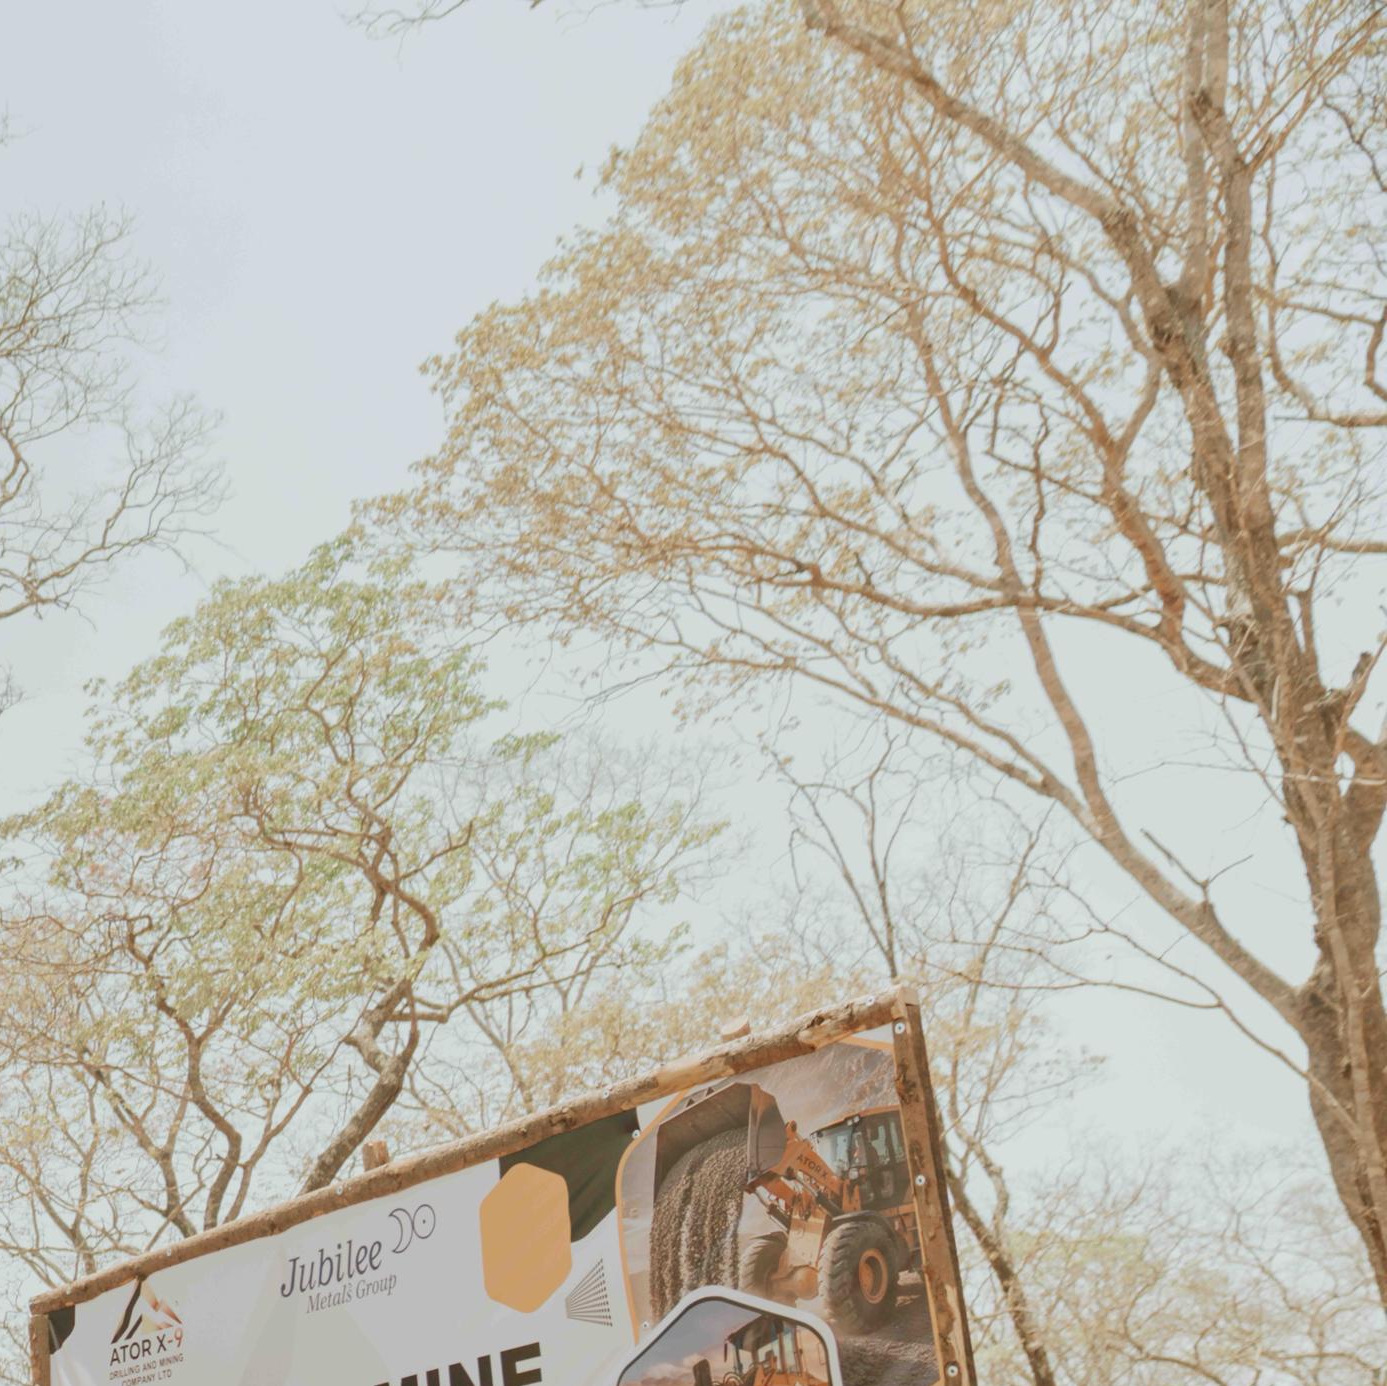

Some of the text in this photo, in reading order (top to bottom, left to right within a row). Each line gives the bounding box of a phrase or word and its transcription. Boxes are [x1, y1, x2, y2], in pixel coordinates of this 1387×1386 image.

[280, 1239, 383, 1298] Jubilee
[306, 1274, 397, 1314] Metals Group
[109, 1328, 184, 1367] ATOR X-9
[109, 1353, 184, 1381] DRILLING AND MINING
[158, 1369, 172, 1381] LTD
